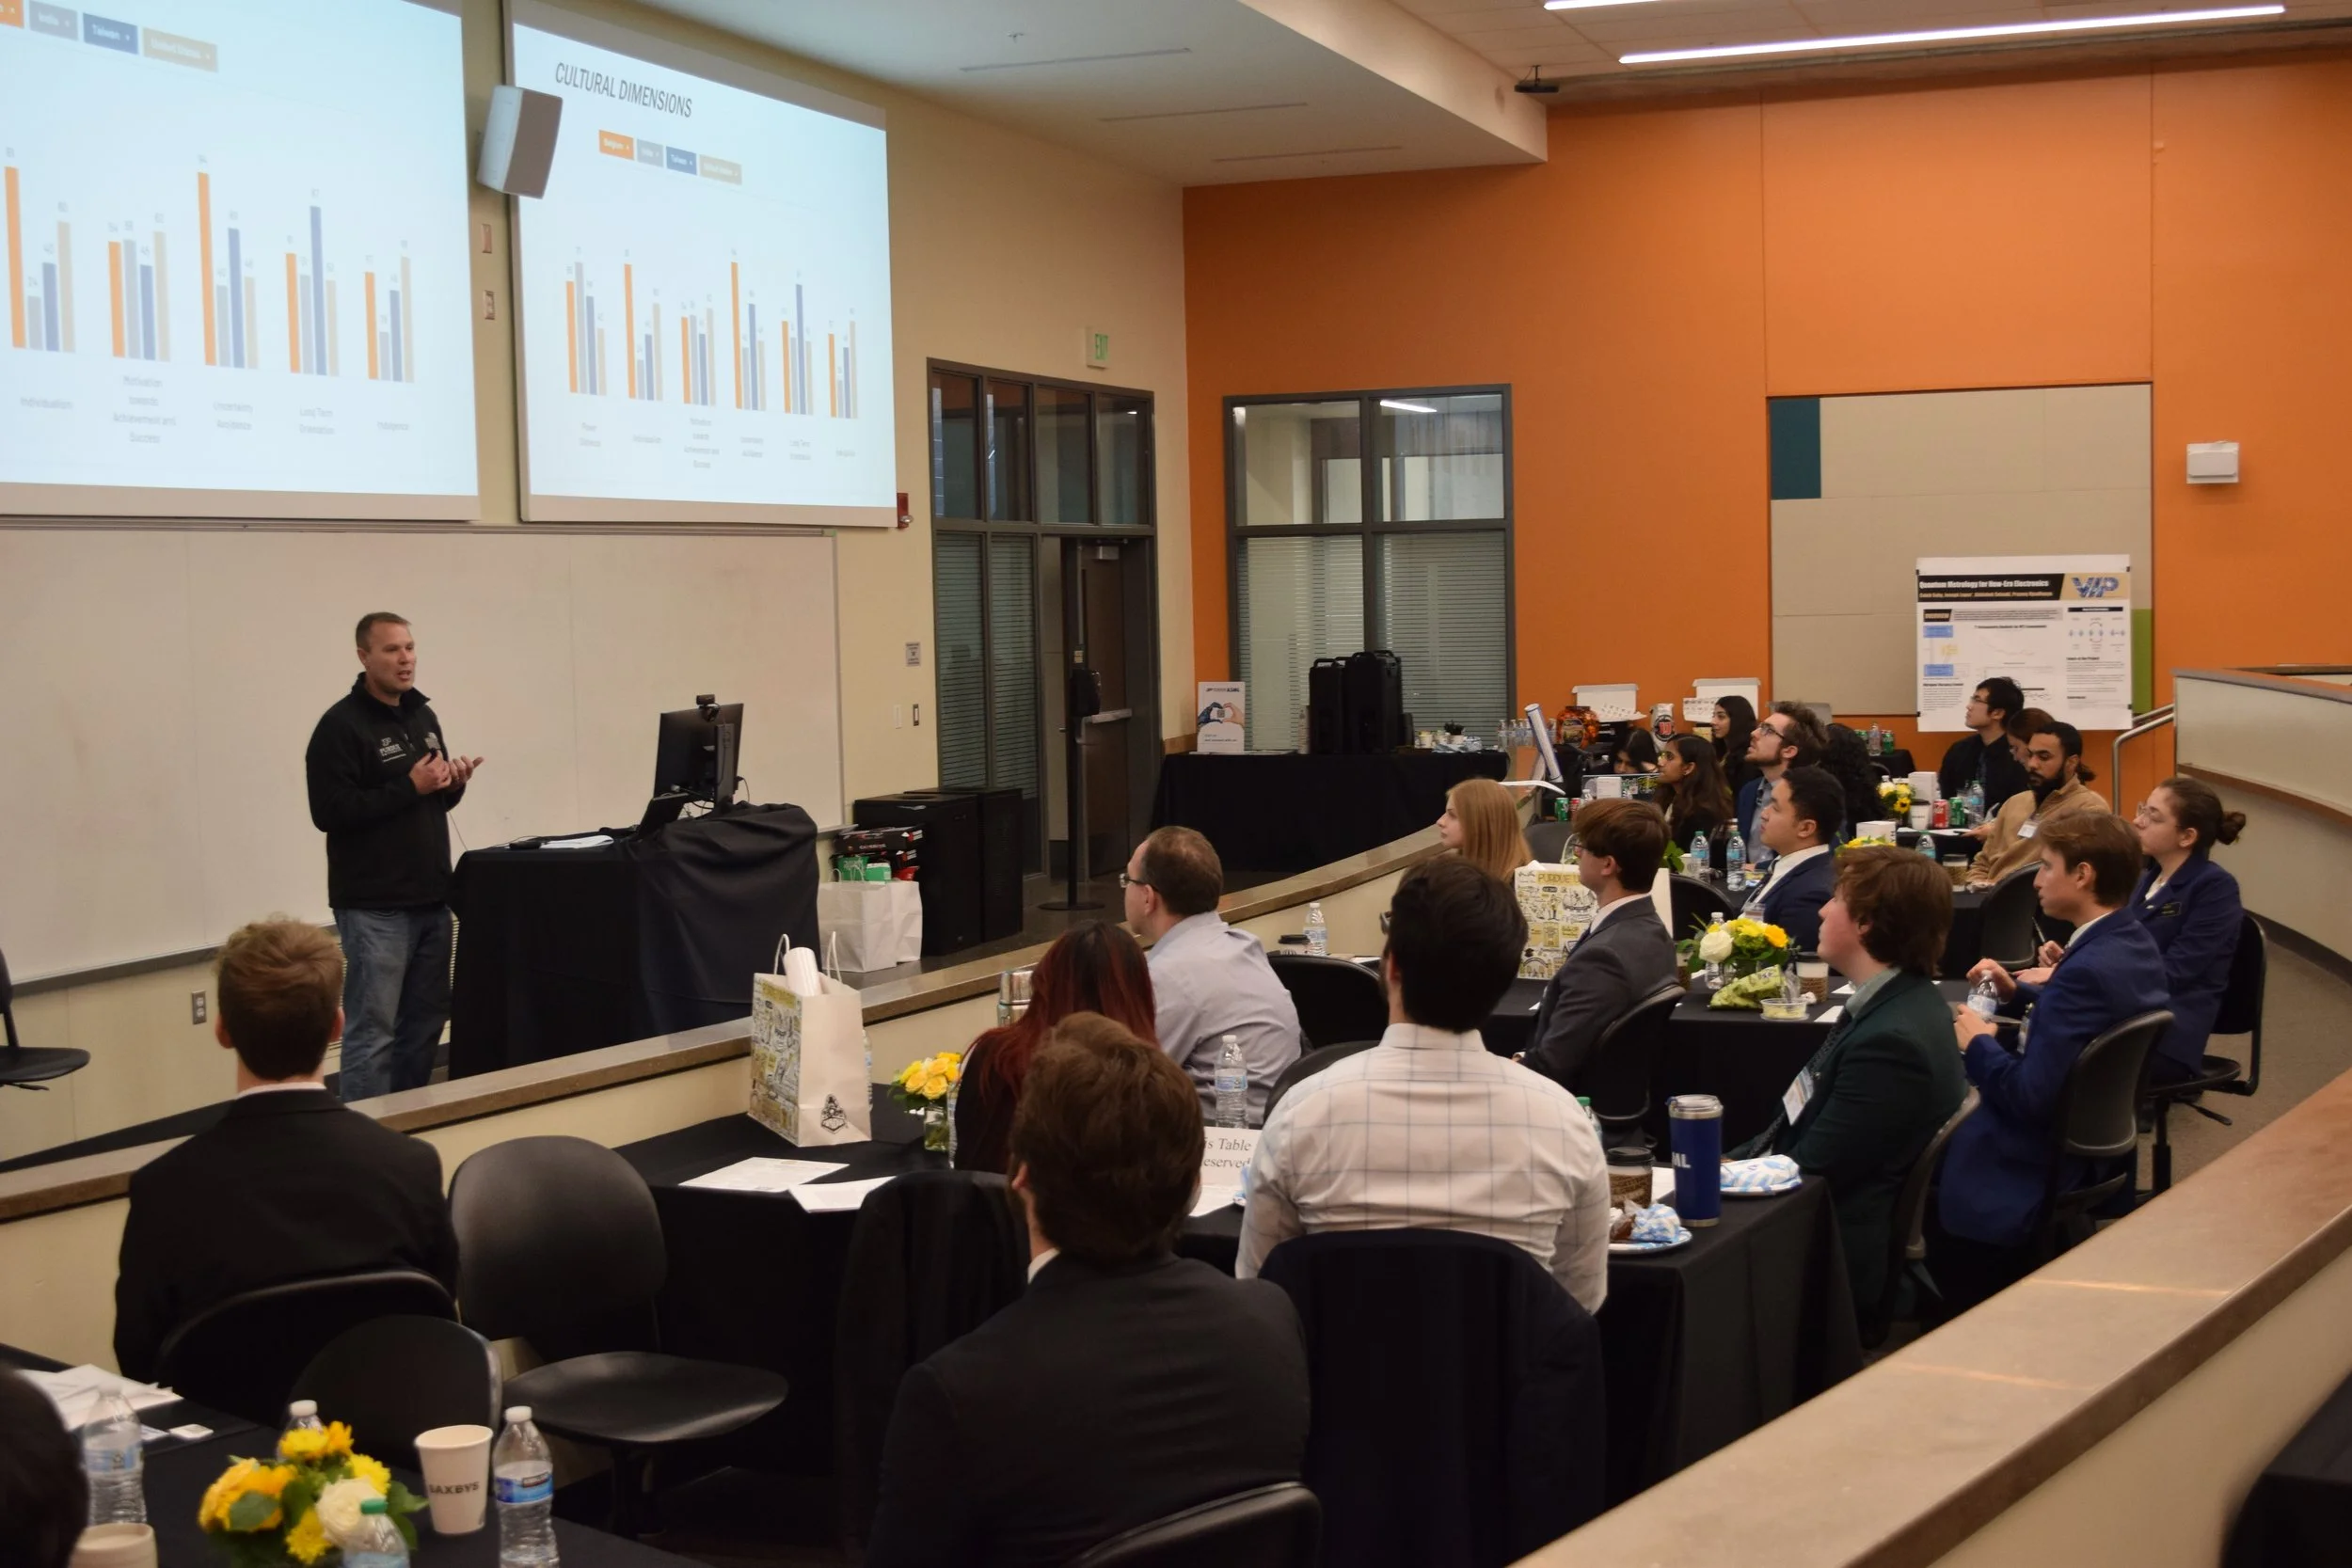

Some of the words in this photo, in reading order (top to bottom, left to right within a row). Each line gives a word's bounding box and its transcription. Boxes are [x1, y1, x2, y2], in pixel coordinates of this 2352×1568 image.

[555, 62, 615, 98] CULTURAL
[618, 79, 692, 118] DIMENSIONS
[1919, 580, 1947, 589] Quantum
[1947, 580, 1978, 589] Metrology
[1219, 1138, 1251, 1151] Table
[1203, 1157, 1250, 1168] eserved
[429, 1481, 479, 1495] SAXBYS
